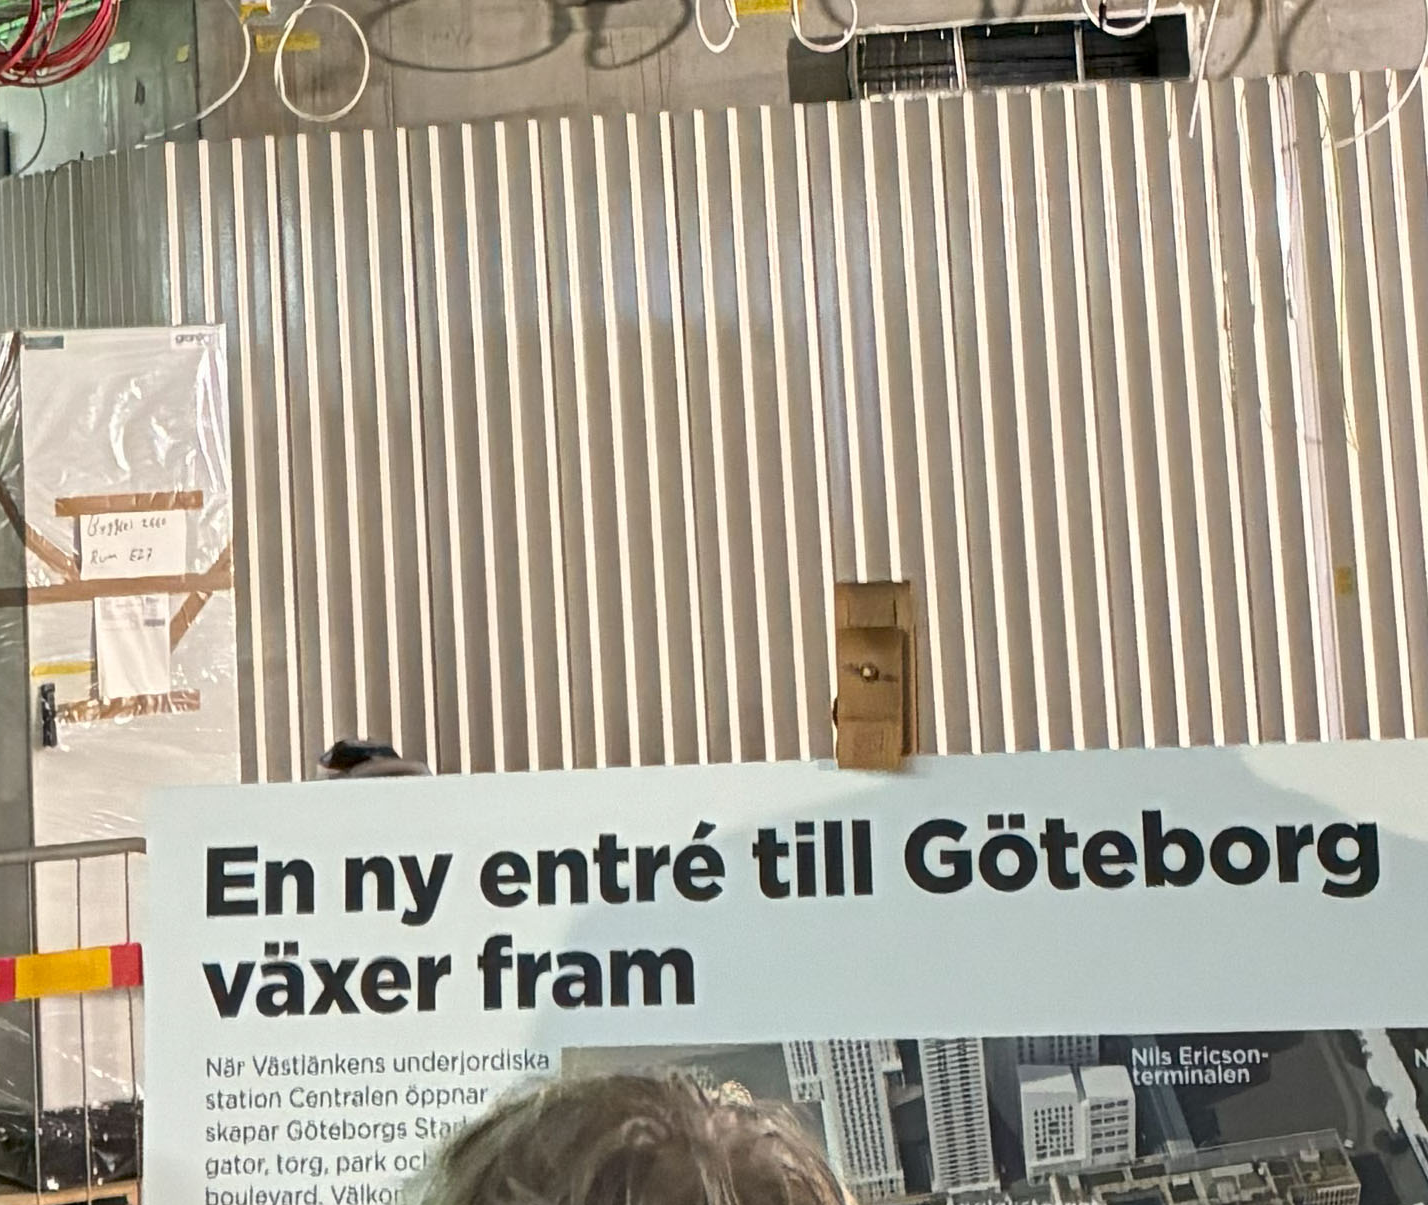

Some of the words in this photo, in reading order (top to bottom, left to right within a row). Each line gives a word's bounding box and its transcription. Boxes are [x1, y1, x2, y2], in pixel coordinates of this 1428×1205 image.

[205, 845, 315, 918] En
[345, 850, 453, 926] ny
[479, 821, 725, 907] entré
[752, 820, 873, 898] till
[904, 809, 1380, 899] Göteborg
[203, 940, 452, 1019] växer
[477, 933, 695, 1011] fram
[206, 1055, 245, 1078] När
[253, 1053, 386, 1076] Västlänkens
[393, 1048, 550, 1077] underjordiska
[1131, 1047, 1172, 1066] Nils
[1178, 1046, 1270, 1066] Ericson-
[1132, 1065, 1251, 1086] terminalen
[205, 1089, 282, 1111] station
[289, 1085, 399, 1109] Centralen
[405, 1084, 489, 1110] öppnar
[205, 1121, 278, 1145] skapar
[286, 1118, 407, 1144] Göteborgs
[205, 1155, 269, 1180] gator,
[277, 1153, 329, 1177] torg,
[336, 1150, 386, 1176] park
